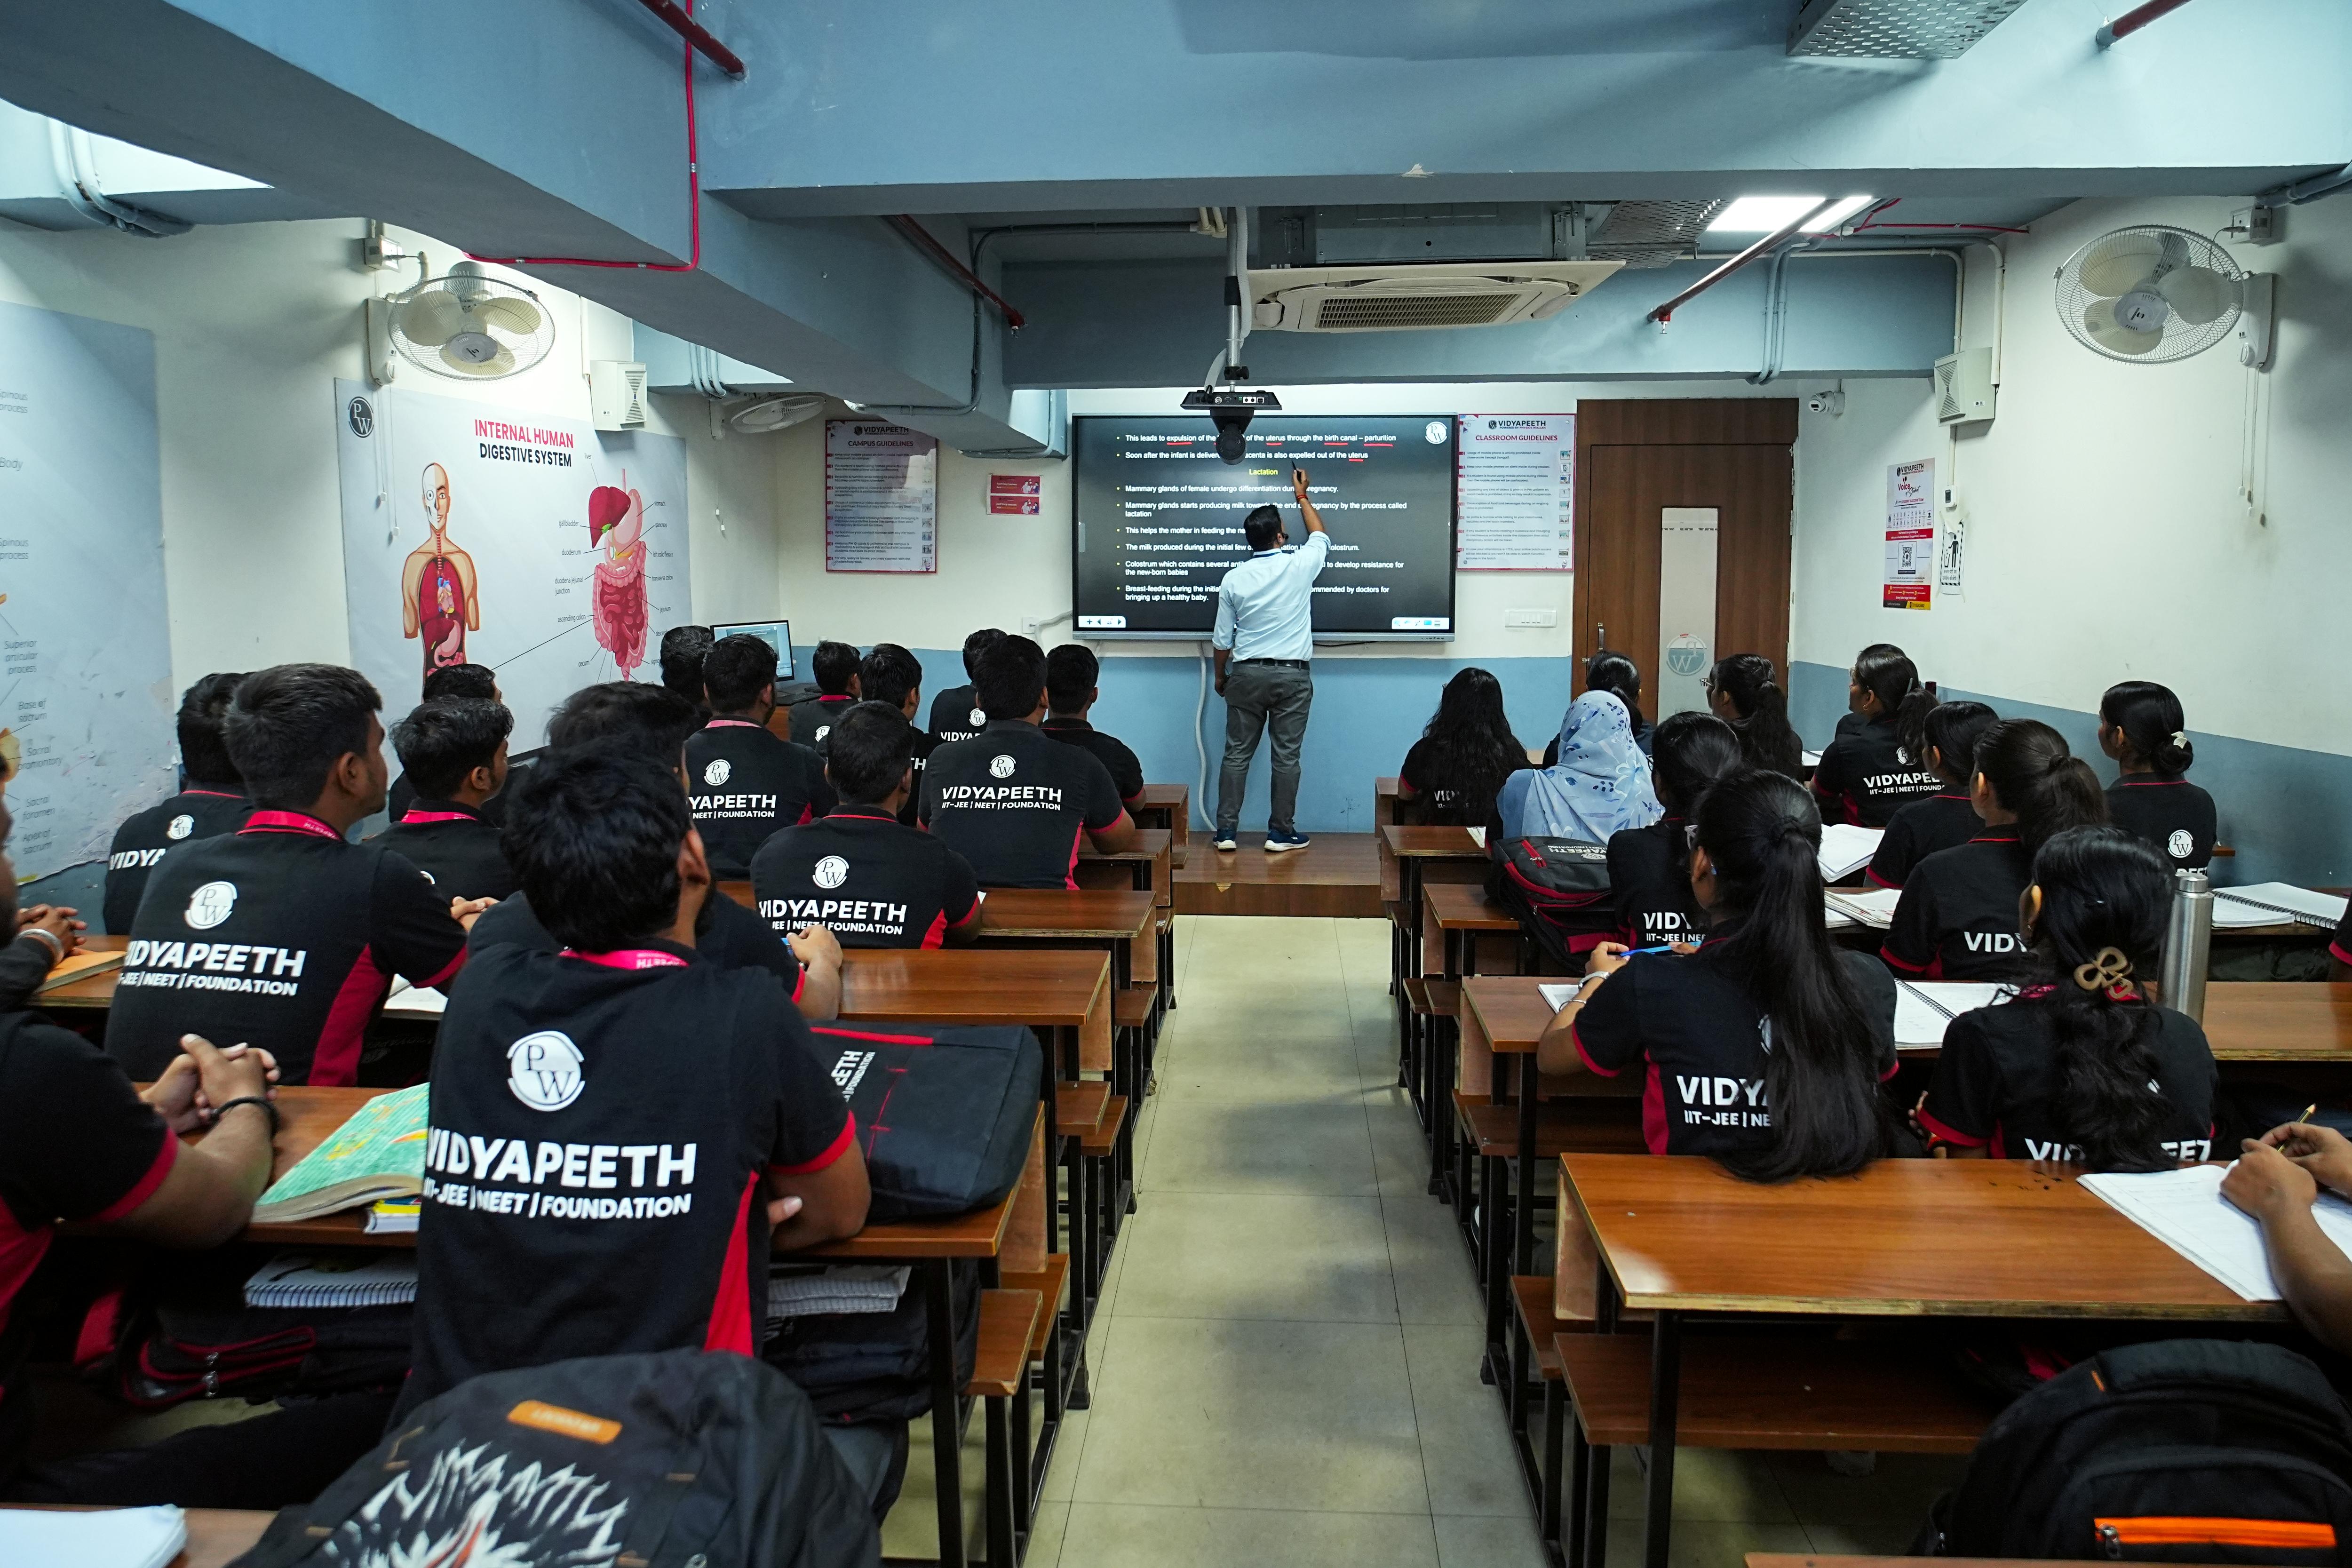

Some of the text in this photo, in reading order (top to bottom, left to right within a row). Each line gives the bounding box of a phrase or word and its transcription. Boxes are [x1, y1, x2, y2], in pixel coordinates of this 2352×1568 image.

[475, 419, 574, 448] INTERNAL HUMAN
[1287, 434, 1312, 443] through
[480, 443, 572, 467] DIGESTIVE SYSTEM
[0, 457, 23, 471] Body
[1901, 463, 1924, 473] VIDYAPEETH
[1125, 485, 1157, 493] Mammary
[1158, 485, 1179, 493] glands
[1898, 483, 1910, 492] Voice
[1125, 501, 1157, 510] Mammary
[1201, 527, 1225, 535] feeding
[1125, 585, 1171, 594] Breast-feeding
[1172, 585, 1192, 594] during
[1346, 586, 1355, 594] by
[1167, 594, 1191, 602] healthy
[1191, 594, 1209, 602] baby.
[4, 640, 38, 650] Superior
[8, 664, 38, 675] process
[942, 786, 1062, 803] VIDYAPEETH
[688, 794, 777, 810] YAPEETH
[1001, 801, 1061, 811] FOUNDATION
[758, 899, 907, 923] VIDYAPEETH
[827, 922, 903, 935] FOUNDATION
[1646, 933, 1680, 941] IIT-JEE
[143, 972, 298, 996] NEET FOUNDATION
[1684, 1110, 1739, 1126] IIT-JEE
[426, 1126, 697, 1189] VIDYAPEETH
[476, 1189, 530, 1215] NEET
[540, 1193, 692, 1220] FOUNDATION
